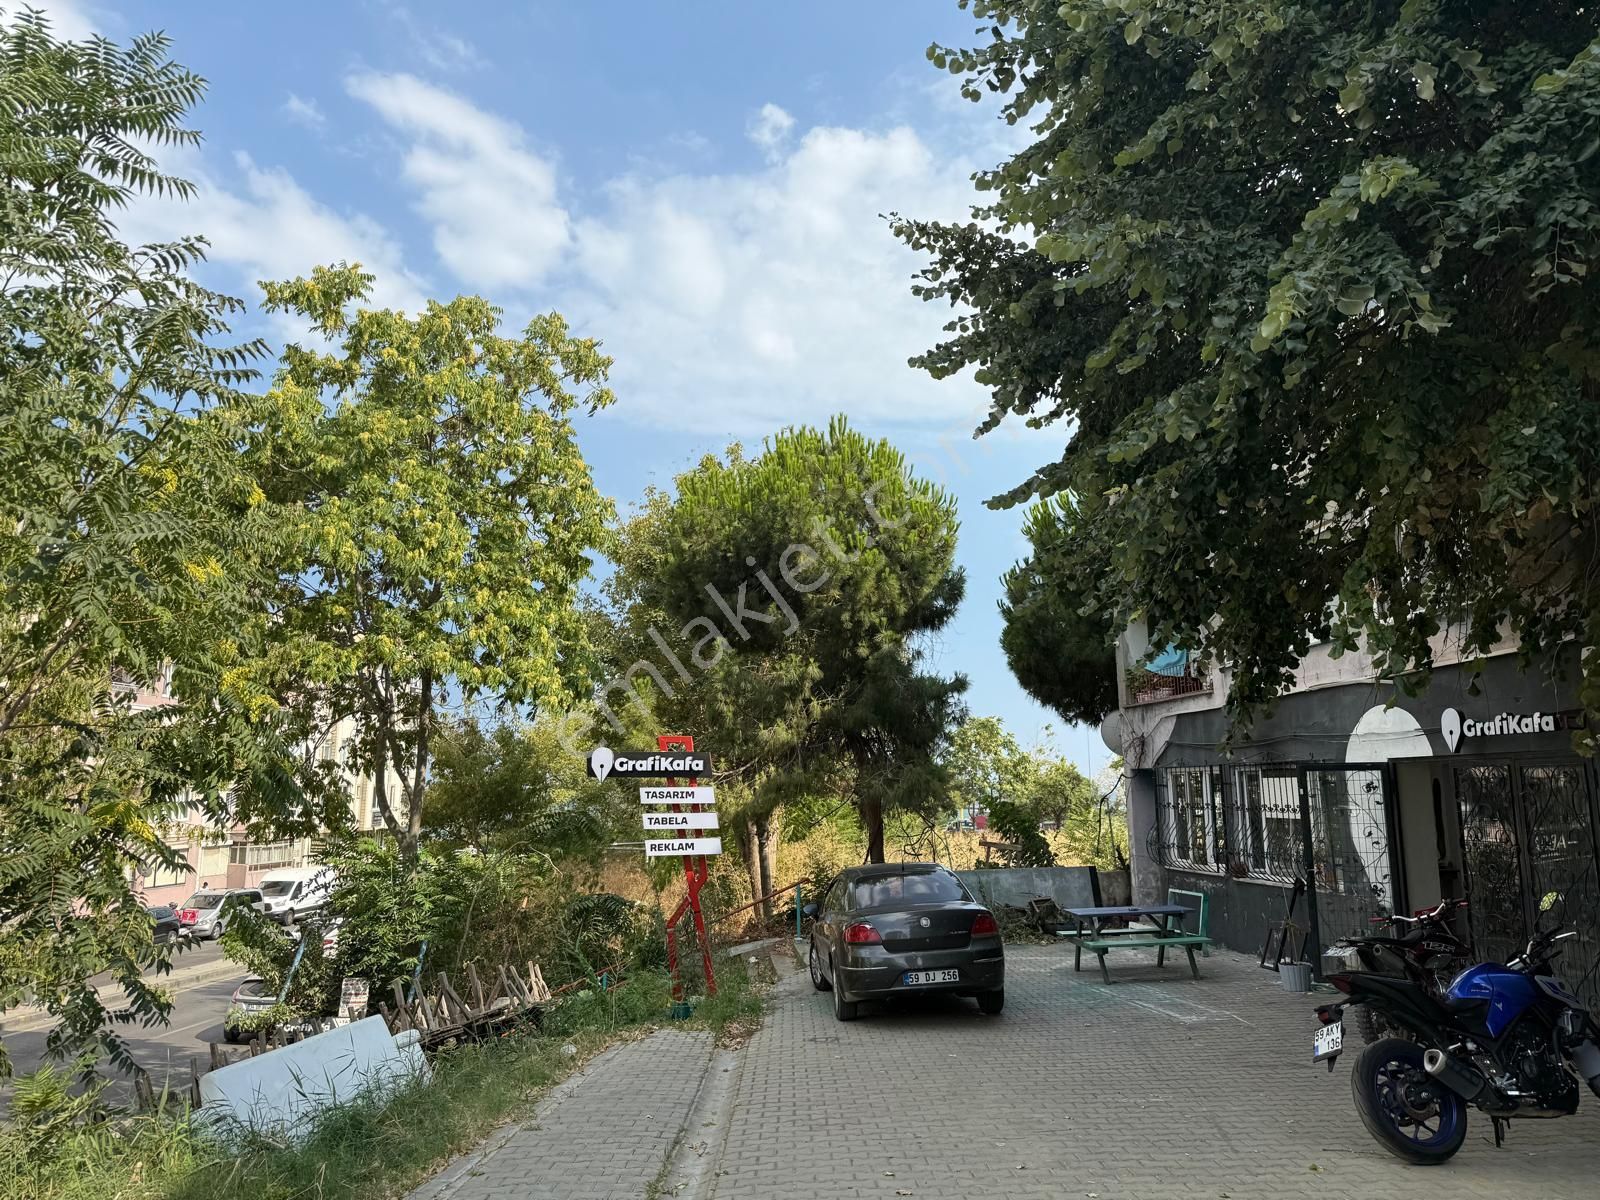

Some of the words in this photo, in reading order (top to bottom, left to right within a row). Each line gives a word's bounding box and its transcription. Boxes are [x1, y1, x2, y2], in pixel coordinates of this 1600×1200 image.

[1463, 712, 1555, 737] GrafiKafa
[614, 756, 704, 772] GrafiKafa
[645, 791, 695, 799] TASARIM
[648, 817, 688, 825] TABELA
[650, 843, 695, 852] REKLAM
[909, 974, 919, 983] 59
[925, 972, 935, 982] DJ
[942, 970, 957, 981] 256
[1315, 1030, 1324, 1041] 59
[1326, 1023, 1340, 1038] AKY
[1327, 1036, 1340, 1050] 136
